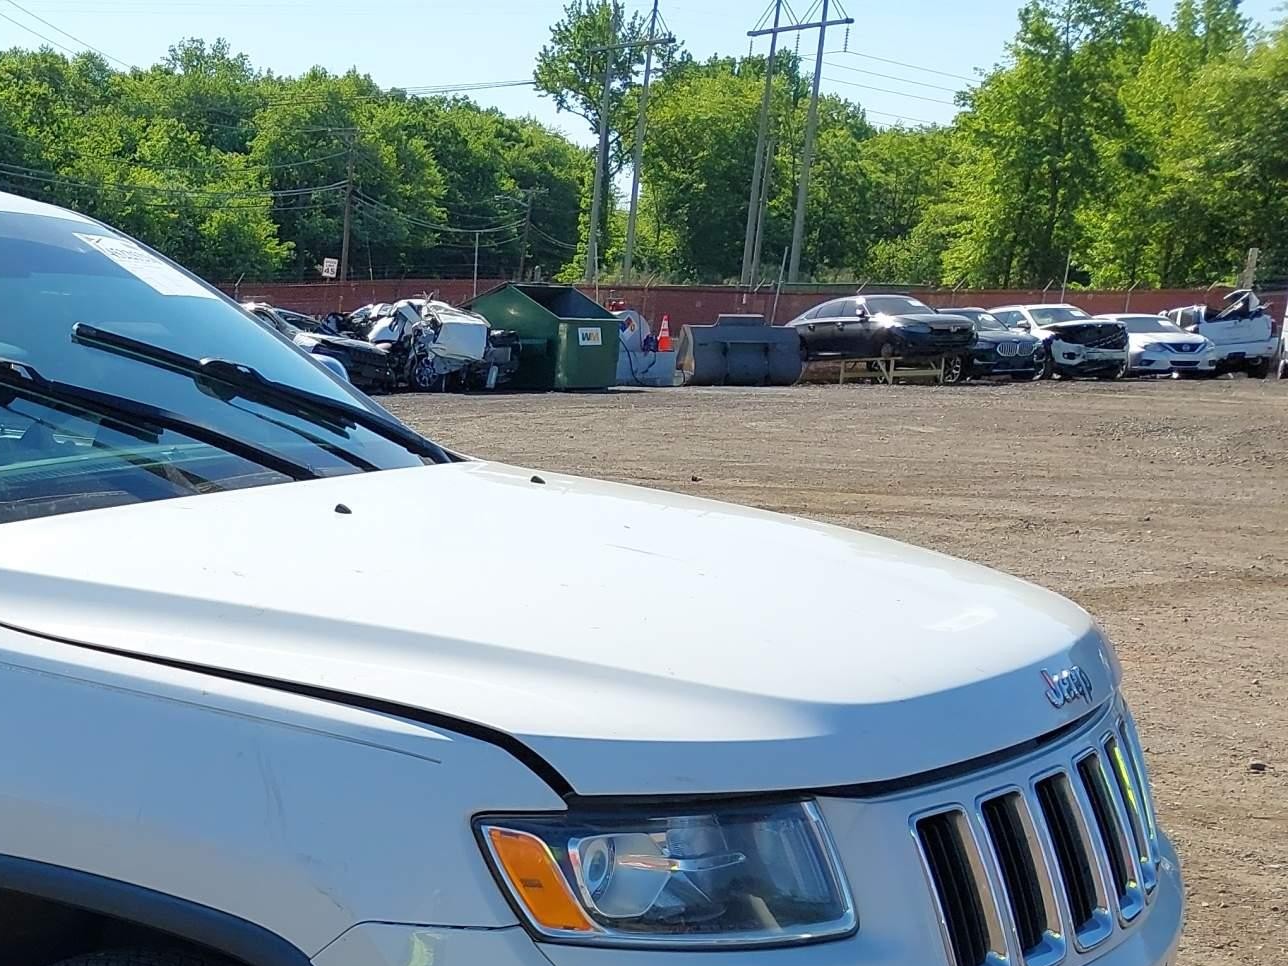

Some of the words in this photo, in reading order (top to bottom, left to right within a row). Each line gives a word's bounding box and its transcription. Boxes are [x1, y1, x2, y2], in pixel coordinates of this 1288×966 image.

[324, 267, 335, 275] 45
[582, 332, 600, 341] WM
[1040, 665, 1092, 709] Jeep
